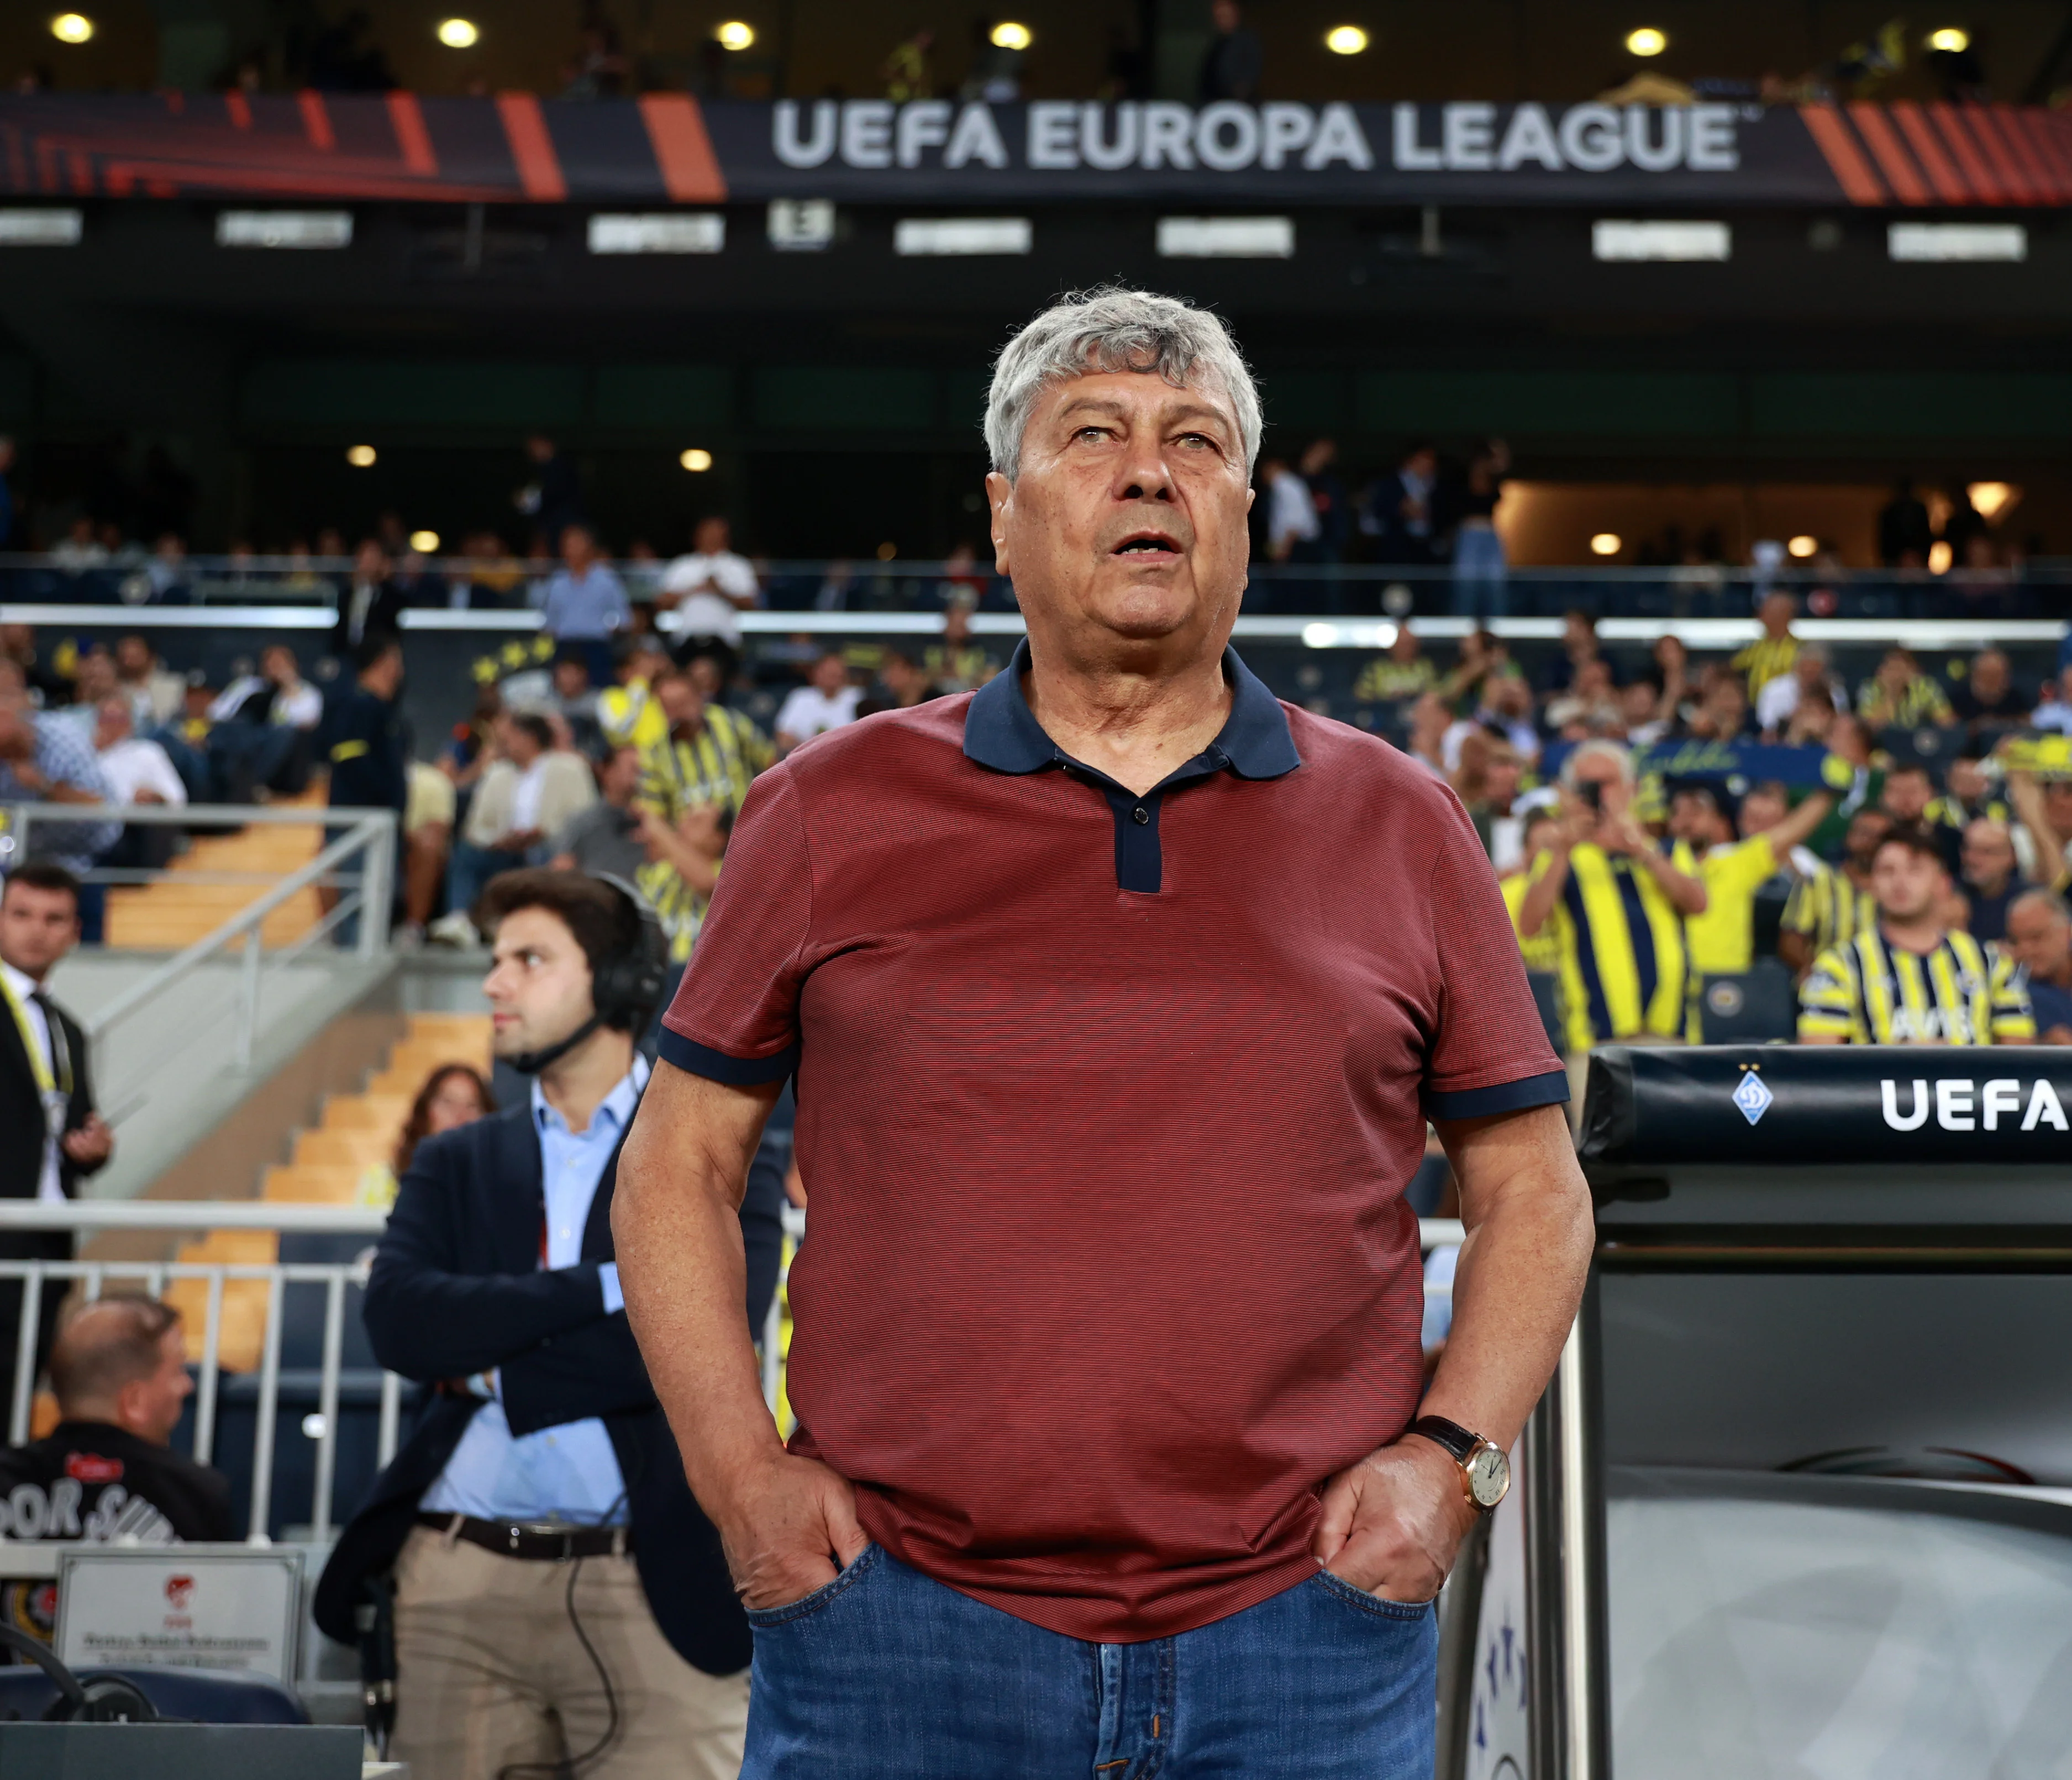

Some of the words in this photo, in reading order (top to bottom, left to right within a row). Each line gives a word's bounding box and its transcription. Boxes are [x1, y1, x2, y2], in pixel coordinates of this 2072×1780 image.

[772, 101, 1008, 168] UEFA
[1028, 101, 1374, 171] EUROPA
[1392, 102, 1739, 172] LEAGUE
[1880, 1079, 2070, 1131] UEFA
[0, 1477, 82, 1539] OR
